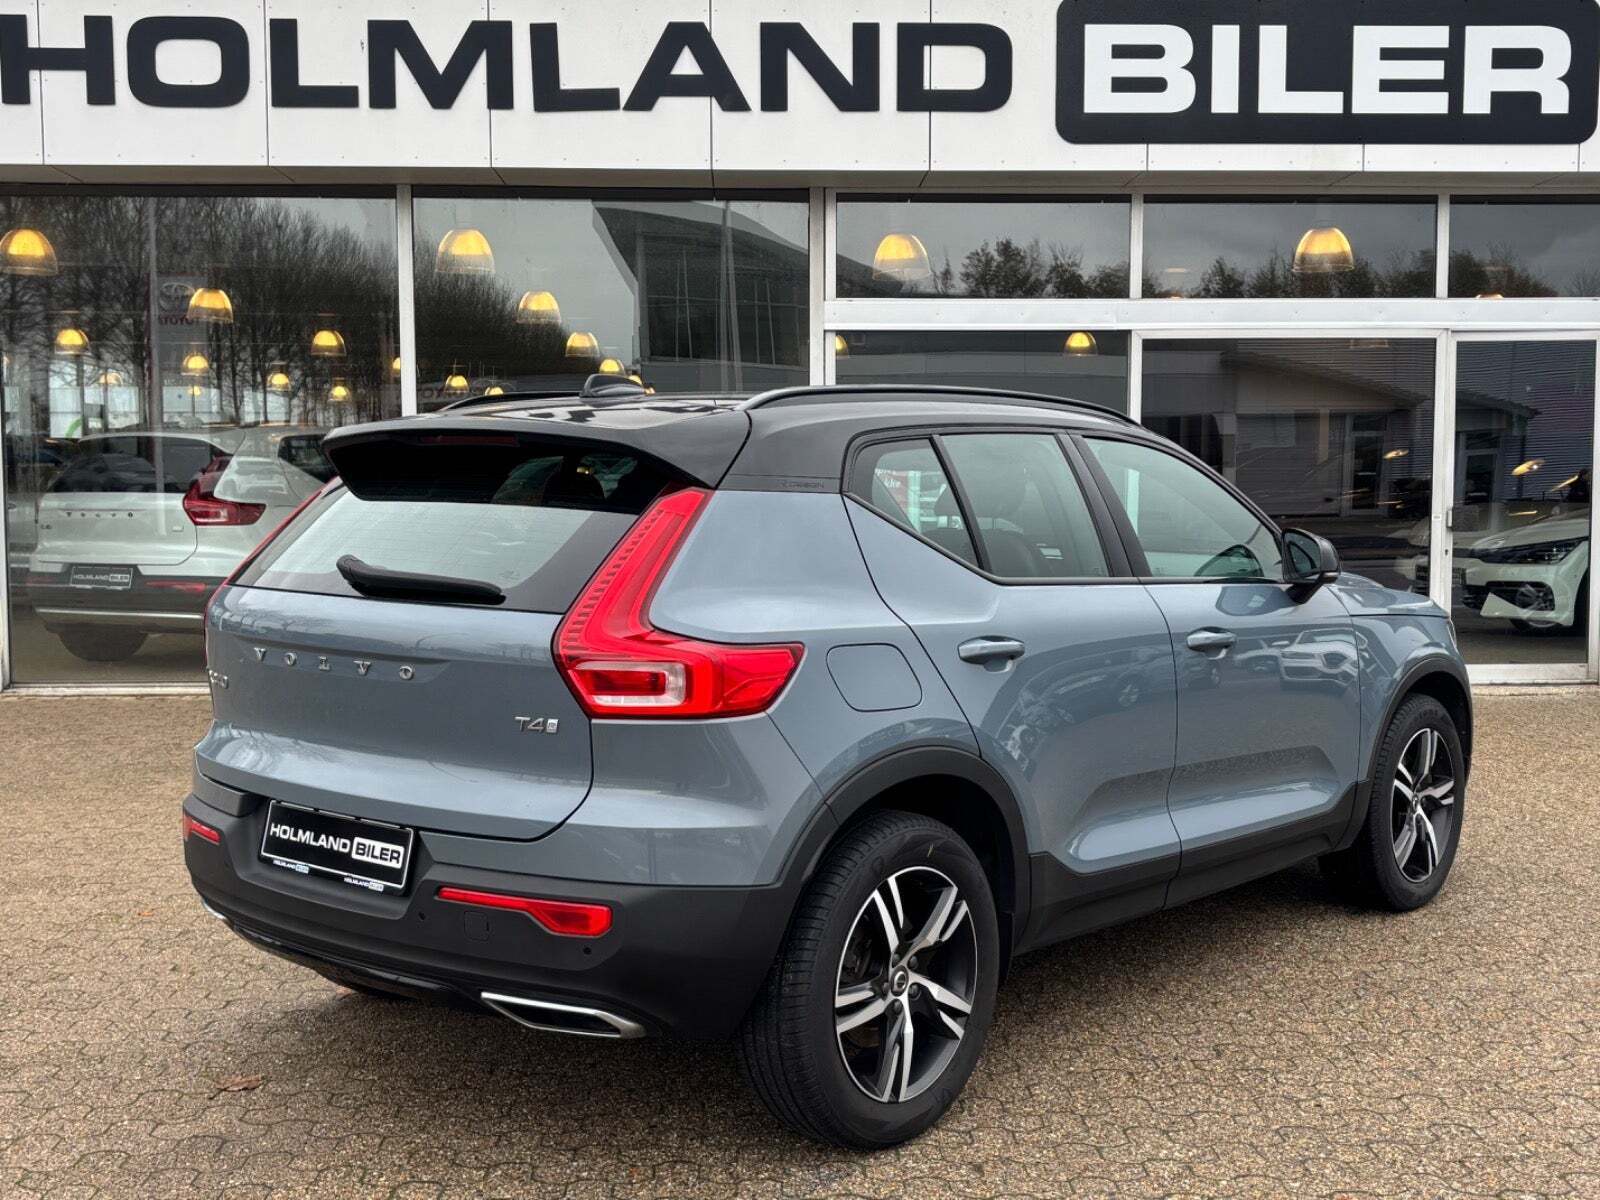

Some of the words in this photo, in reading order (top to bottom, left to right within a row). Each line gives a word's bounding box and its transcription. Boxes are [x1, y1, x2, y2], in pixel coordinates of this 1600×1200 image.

[0, 14, 1013, 112] HOLMLAND
[1083, 24, 1572, 115] BILER
[253, 646, 415, 681] VOLVO
[269, 822, 351, 854] HOLMLAND
[354, 842, 402, 865] BILER
